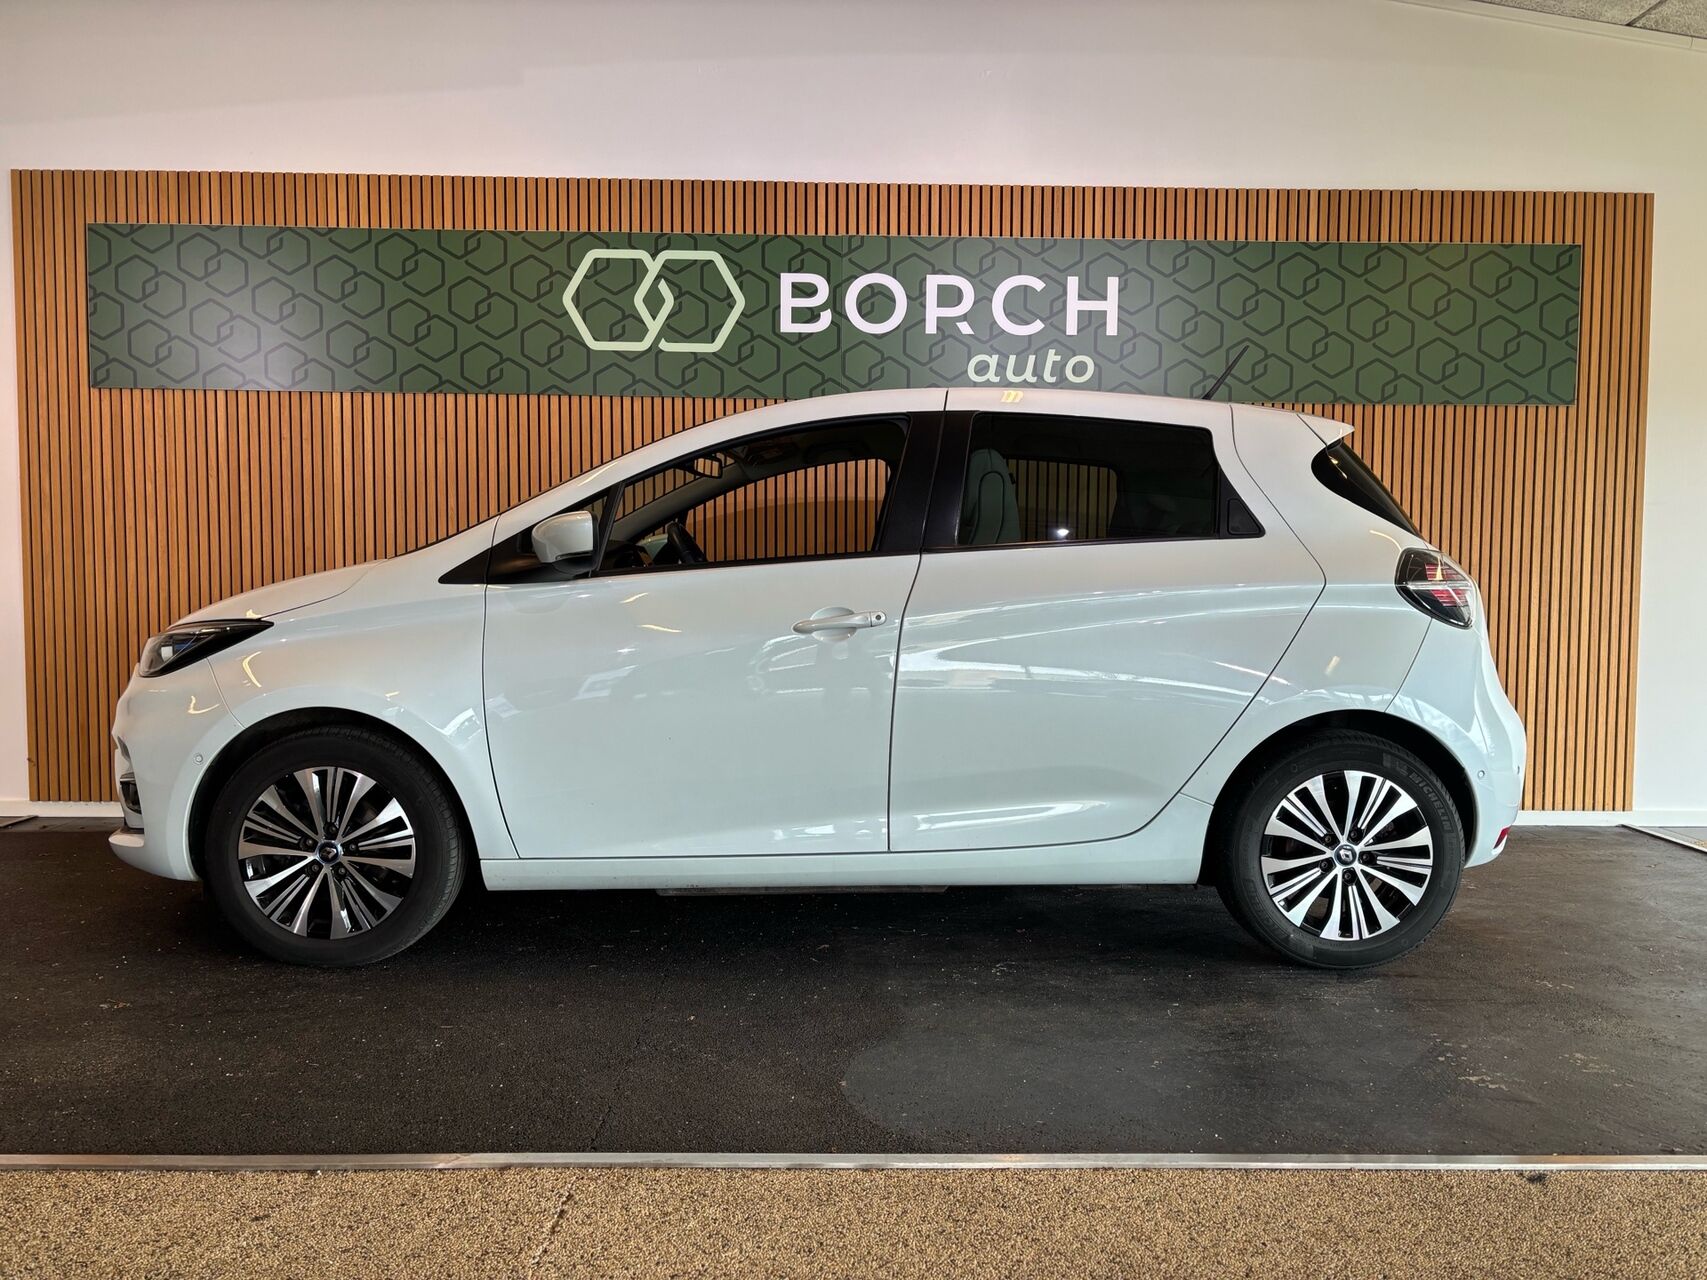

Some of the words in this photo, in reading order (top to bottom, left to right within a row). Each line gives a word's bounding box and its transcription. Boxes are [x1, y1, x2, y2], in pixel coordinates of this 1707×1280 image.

[779, 272, 1119, 336] BORCH
[967, 349, 1095, 383] auto
[1408, 771, 1452, 831] MICHELIN
